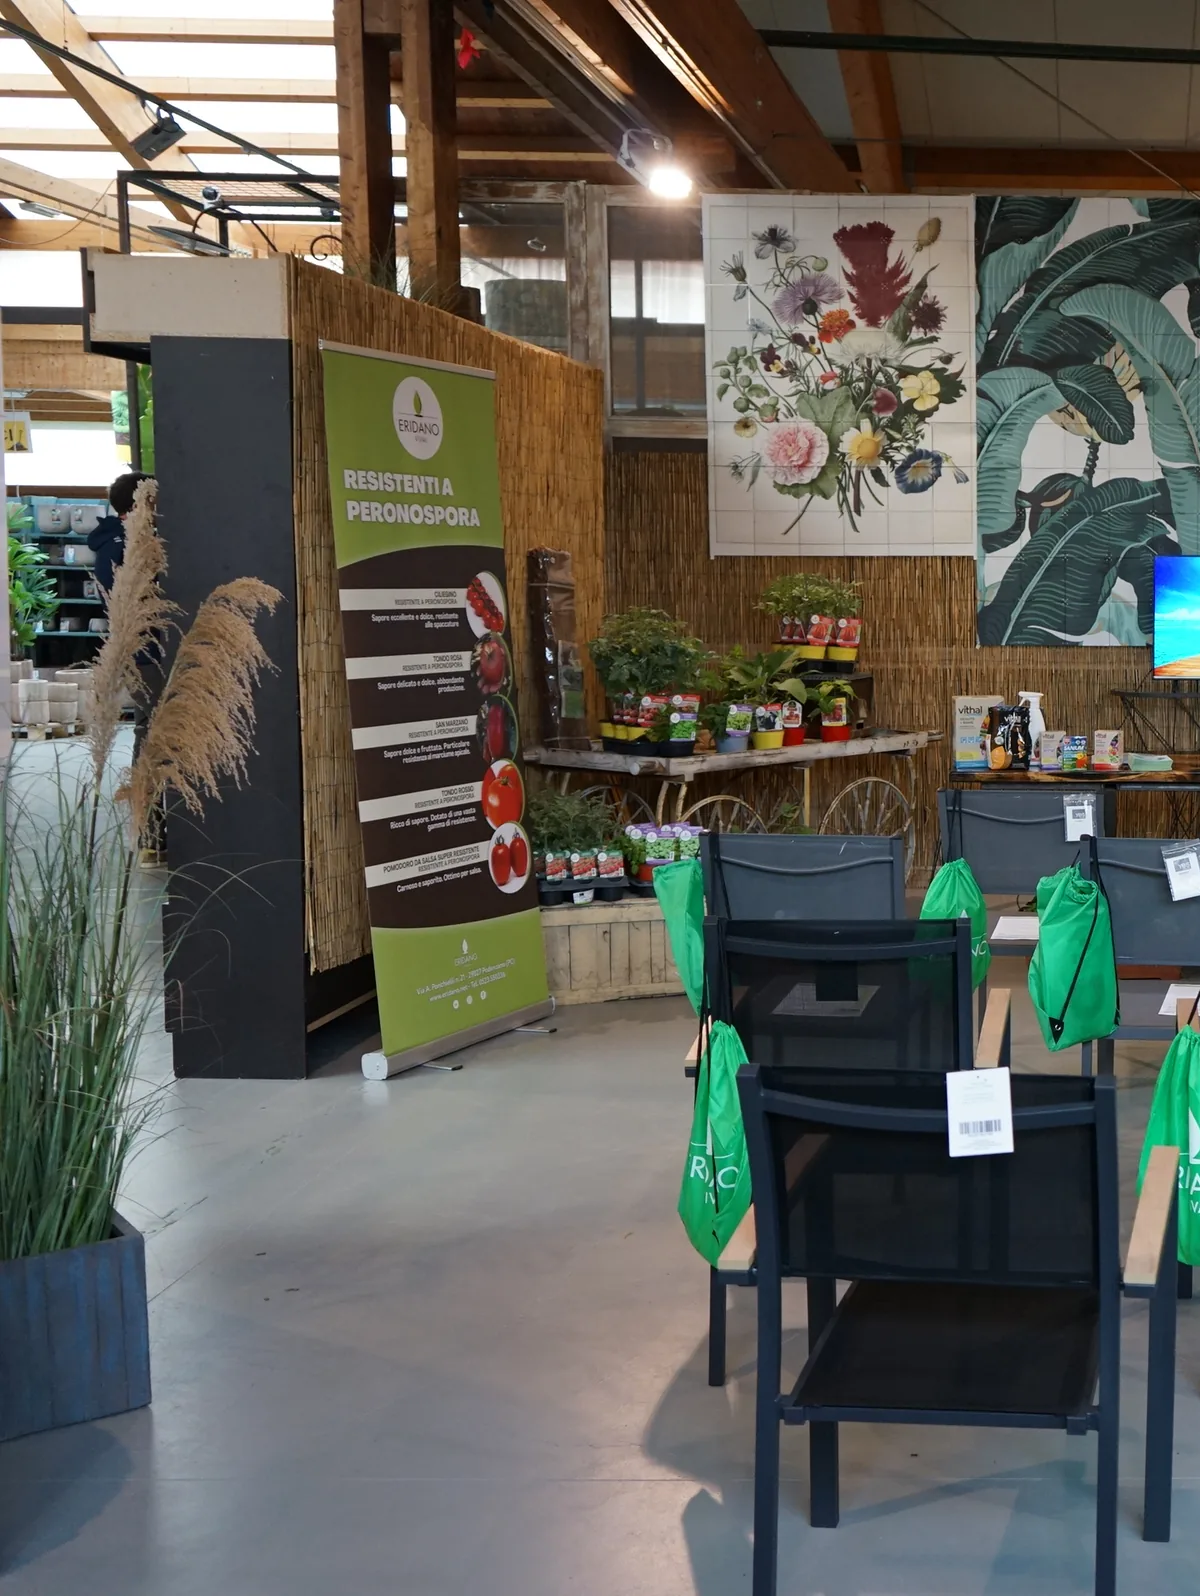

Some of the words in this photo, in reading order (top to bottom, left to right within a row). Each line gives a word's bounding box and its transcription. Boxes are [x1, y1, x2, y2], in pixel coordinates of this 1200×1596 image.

[398, 418, 440, 436] ERIDANO
[344, 469, 440, 495] RESISTENTI
[442, 478, 454, 496] A
[346, 500, 480, 528] PERONOSPORA
[371, 614, 390, 623] Sapore
[431, 662, 463, 670] PERONOSPORA
[377, 681, 396, 690] Sapore
[397, 680, 416, 688] delicato
[436, 677, 464, 685] abbondante
[436, 721, 446, 729] SAN
[446, 719, 469, 727] MARZANO
[408, 730, 433, 739] RESISTENTE
[438, 726, 469, 735] PERONOSPORA
[384, 750, 402, 759] Sapore
[402, 747, 416, 755] dolce
[443, 741, 470, 750] Particolare
[432, 751, 454, 760] marciume
[441, 788, 457, 797] TONDO
[458, 785, 474, 793] ROSSO
[414, 799, 439, 809] RESISTENTE
[443, 793, 475, 803] PERONOSPORA
[390, 821, 405, 830] Ricco
[430, 812, 447, 821] Dotato
[463, 807, 476, 815] vasta
[427, 823, 445, 832] gamma
[383, 860, 413, 874] POMODORO
[422, 854, 437, 864] SALSA
[438, 851, 453, 860] SUPER
[453, 846, 479, 857] RESISTENTE
[418, 861, 444, 872] RESISTENTE
[448, 853, 480, 865] PERONOSPORA
[396, 882, 418, 893] Carnoso
[443, 872, 460, 881] Ottimo
[460, 870, 468, 878] per
